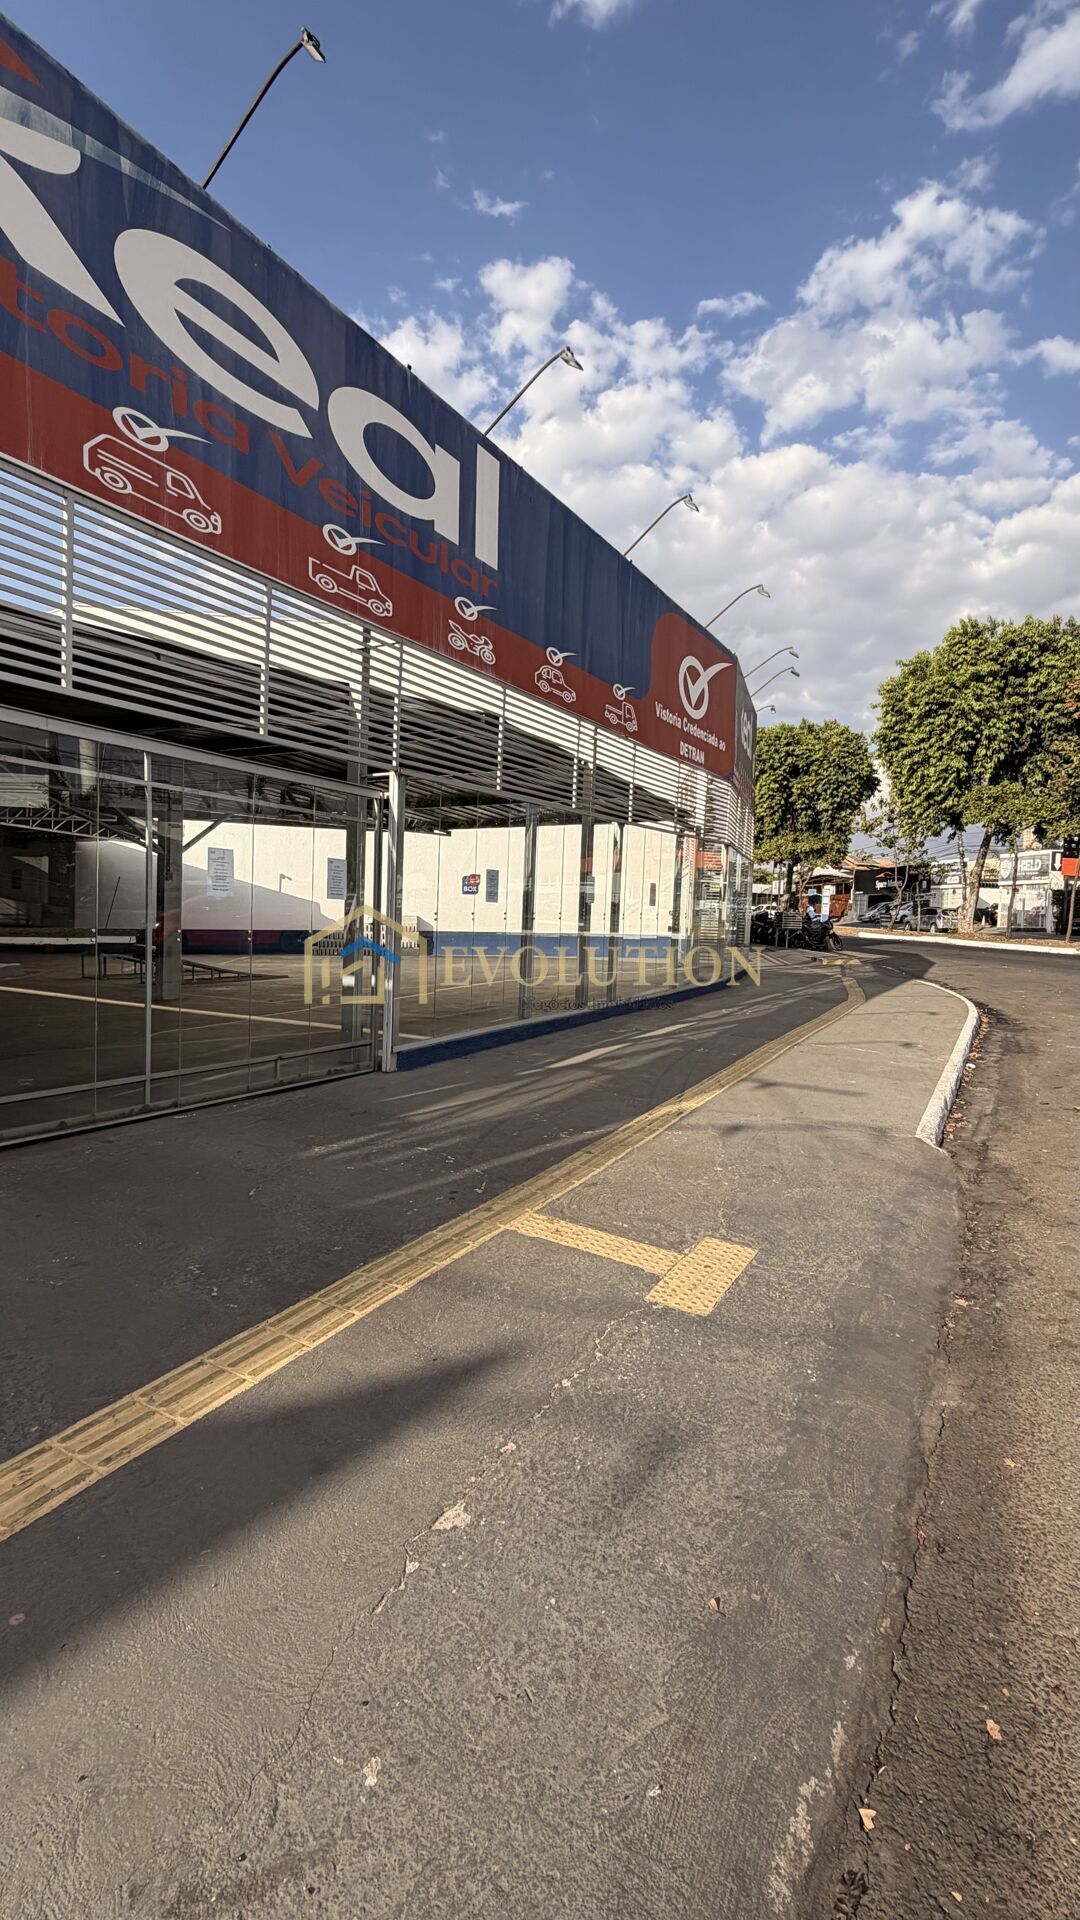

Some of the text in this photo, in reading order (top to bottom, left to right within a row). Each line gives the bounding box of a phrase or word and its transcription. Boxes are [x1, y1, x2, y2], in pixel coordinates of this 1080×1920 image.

[271, 431, 497, 598] Veicular
[655, 701, 682, 729] Vistoria
[682, 717, 718, 748] Credenciada
[680, 741, 705, 764] DETRAN
